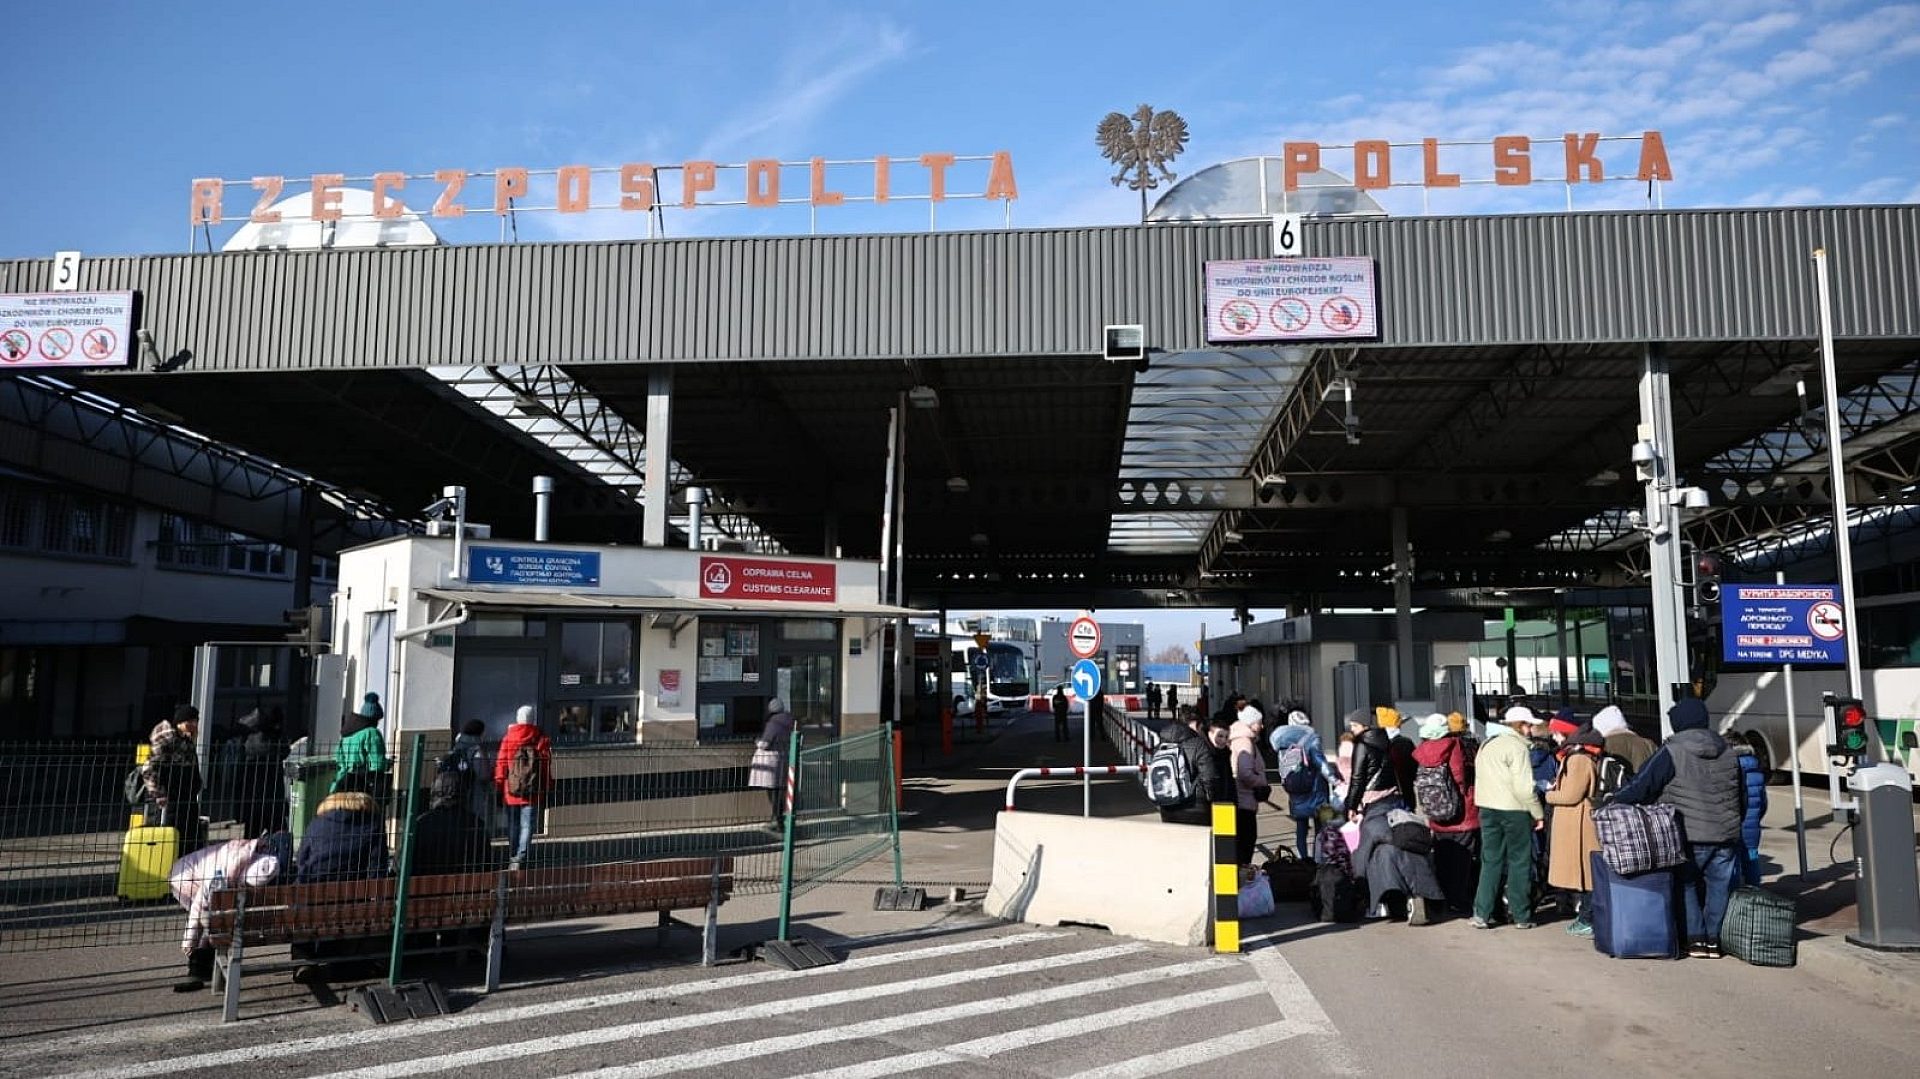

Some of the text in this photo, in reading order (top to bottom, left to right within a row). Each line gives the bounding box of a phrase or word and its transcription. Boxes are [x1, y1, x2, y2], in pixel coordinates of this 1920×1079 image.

[192, 131, 1673, 226] RZECZPOSPOLITA POLSKA
[1280, 219, 1294, 249] 6
[59, 257, 72, 284] 5
[1245, 263, 1333, 274] NIE WPROWADZAJ
[1237, 288, 1252, 297] DO
[1254, 287, 1275, 296] UNII
[24, 298, 38, 306] NIE
[14, 319, 27, 328] DO
[510, 556, 545, 564] KONTROLA
[743, 567, 813, 579] ODPRAWA CELNA
[742, 584, 832, 596] CUSTOMS CLEARANCE
[1738, 651, 1748, 659] NA
[1797, 650, 1829, 660] MEDYKA
